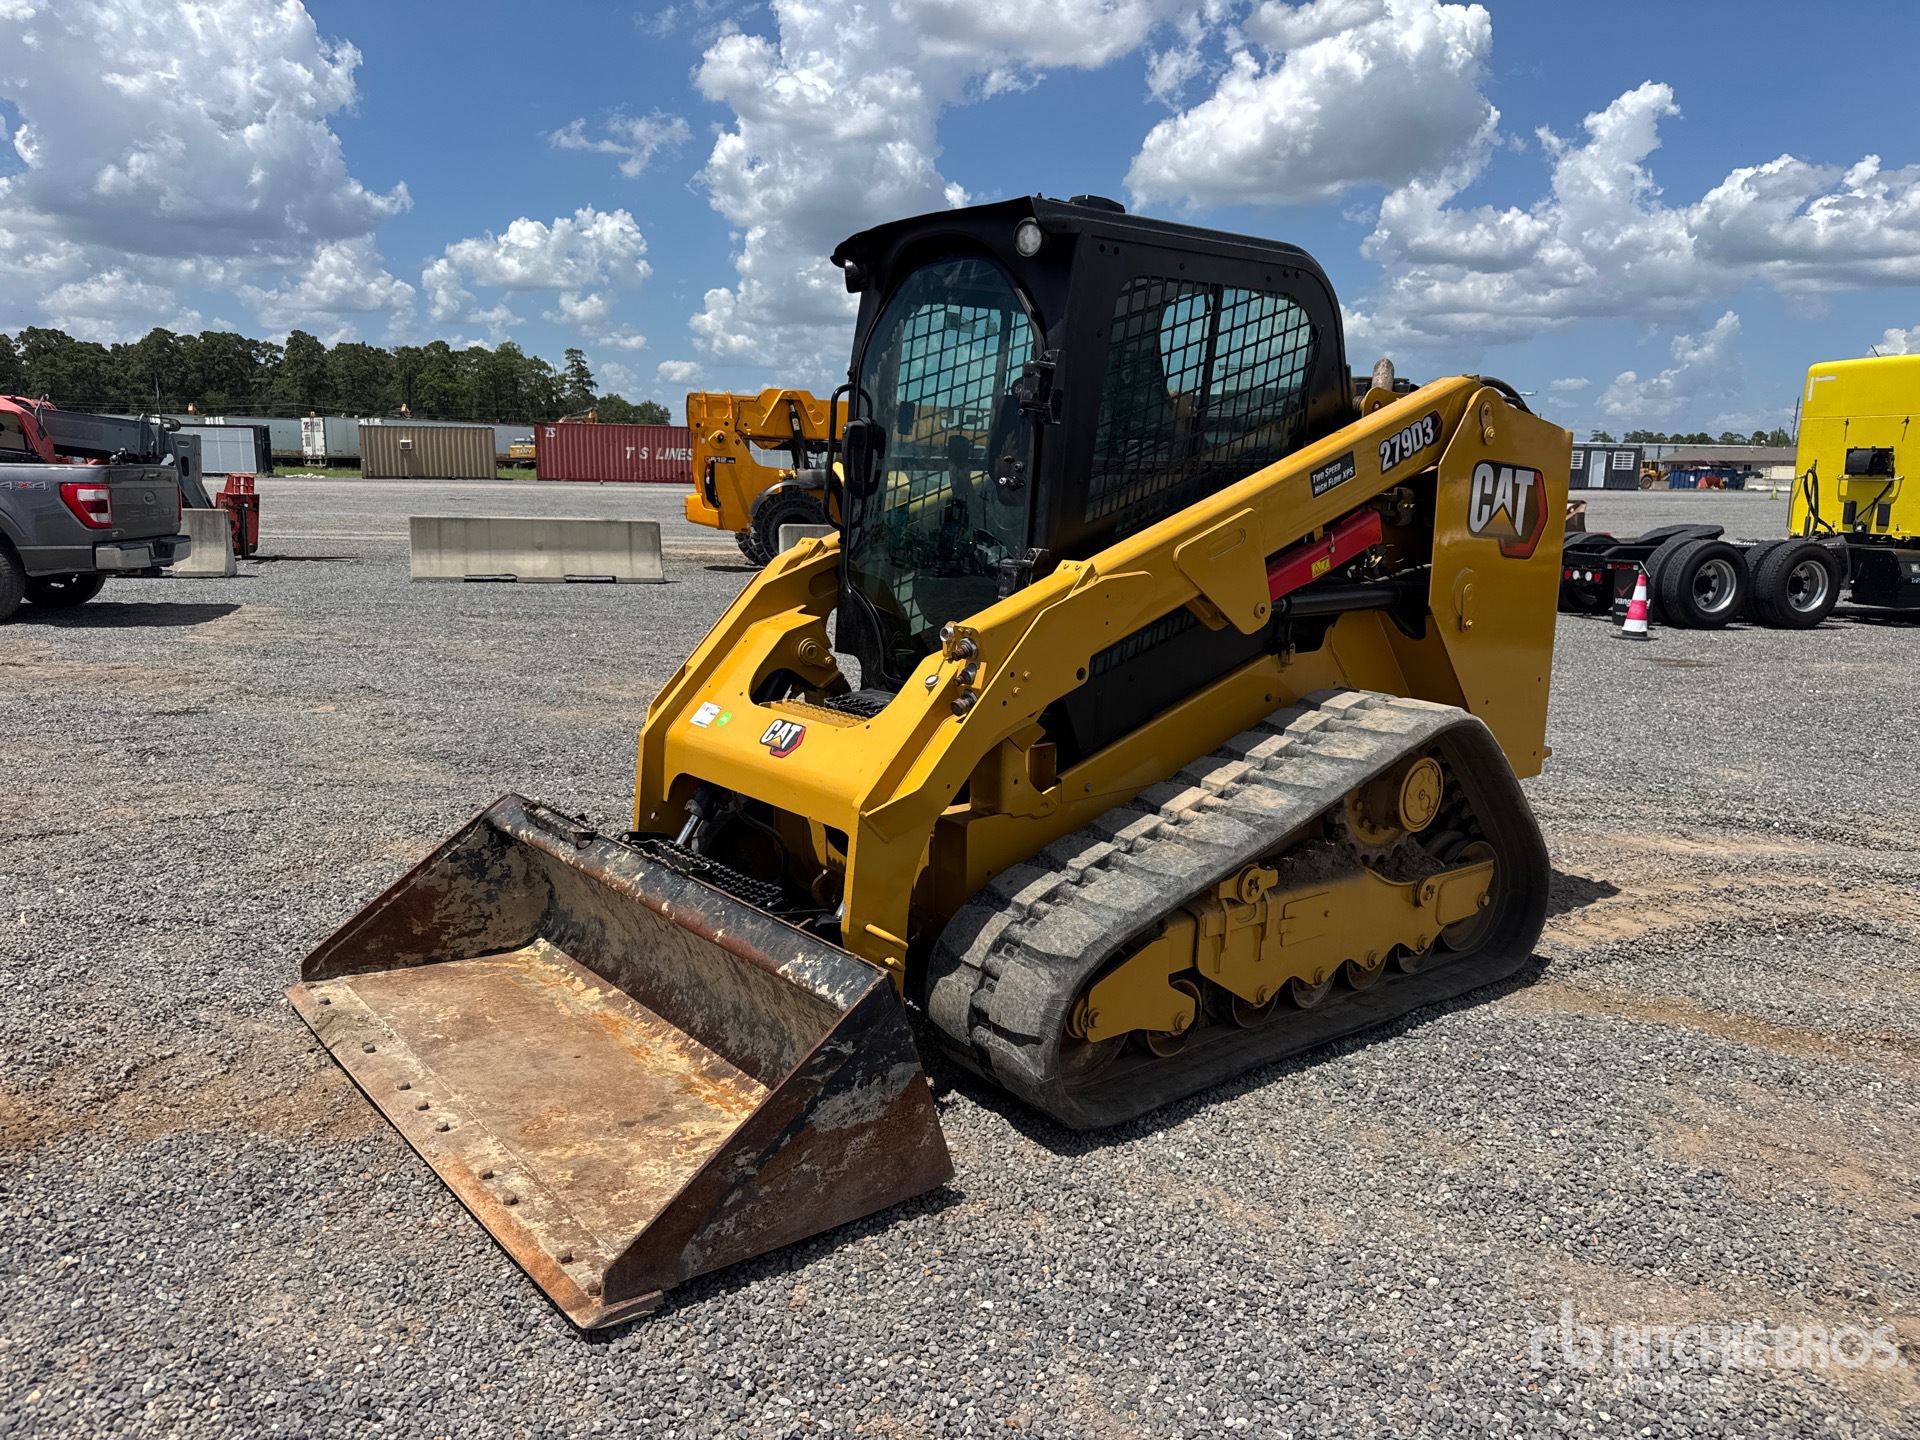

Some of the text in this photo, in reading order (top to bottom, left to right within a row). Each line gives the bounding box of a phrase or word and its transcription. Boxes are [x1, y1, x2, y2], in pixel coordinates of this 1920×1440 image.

[626, 446, 694, 461] T S LINES
[1379, 417, 1435, 472] 279D3
[1342, 466, 1354, 480] XPS
[1469, 463, 1535, 537] CAT
[1614, 597, 1651, 608] vangd
[761, 719, 803, 750] CAT
